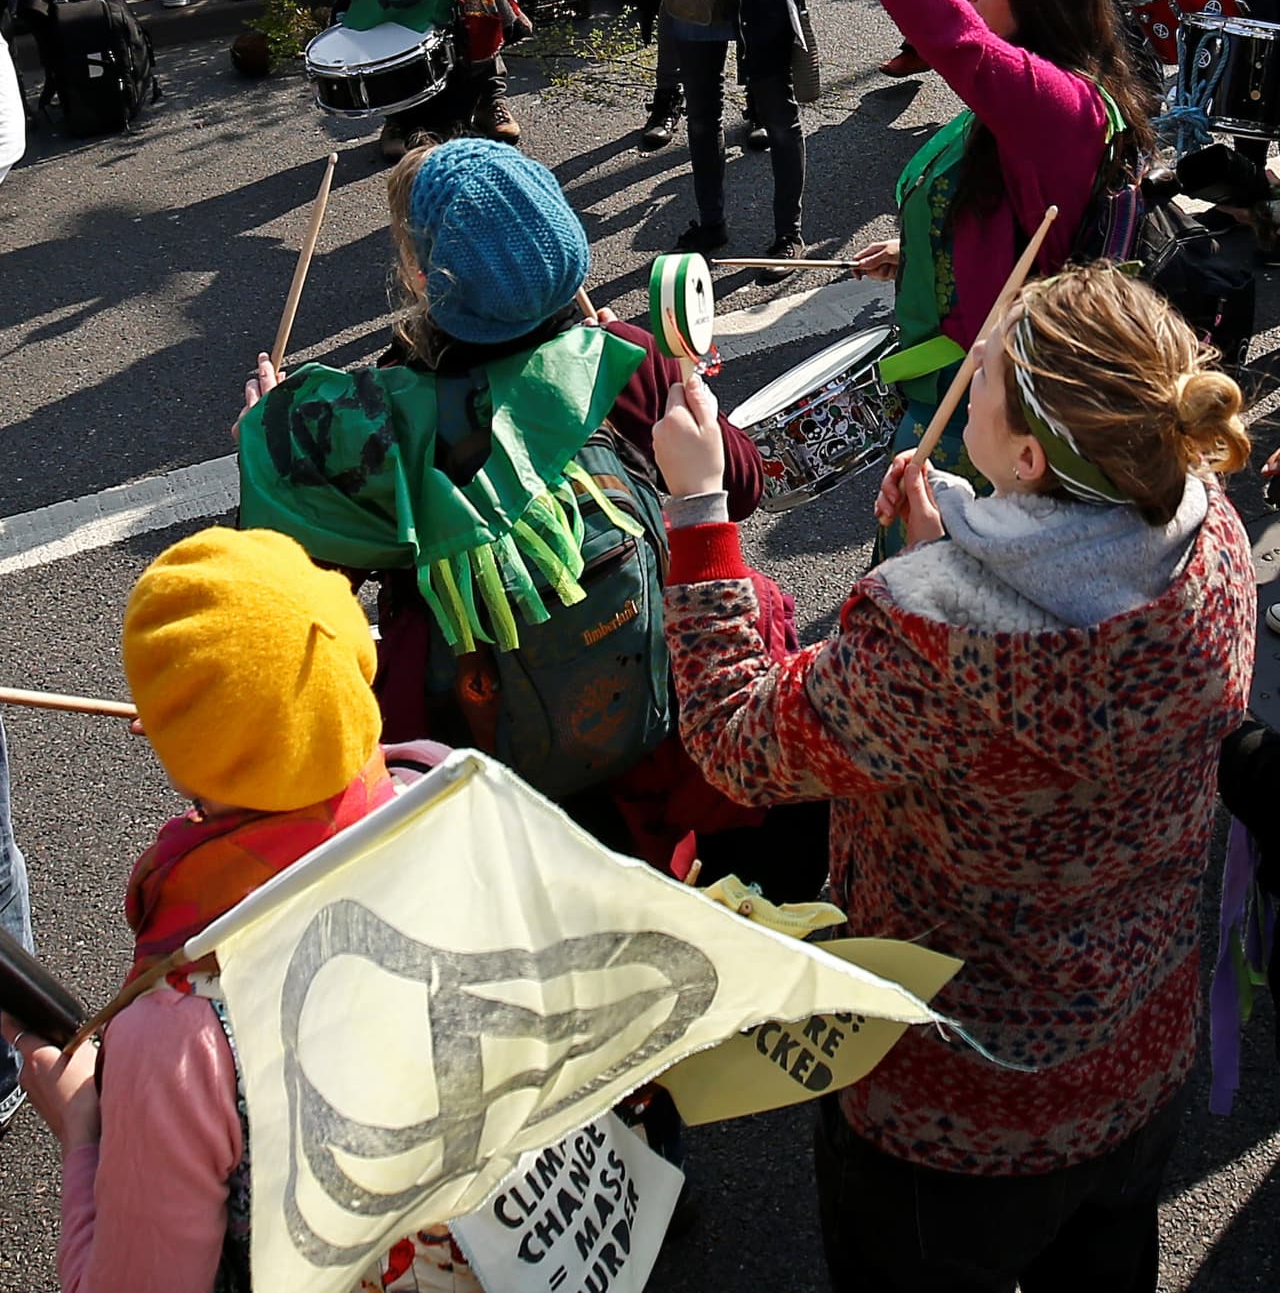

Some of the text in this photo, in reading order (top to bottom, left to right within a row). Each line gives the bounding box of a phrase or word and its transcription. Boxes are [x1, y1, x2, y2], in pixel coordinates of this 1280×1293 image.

[740, 1019, 833, 1092] CKED
[494, 1139, 566, 1229] CLIM
[517, 1123, 607, 1264] CHANGE
[574, 1149, 626, 1261] MASS
[577, 1178, 640, 1293] URDER
